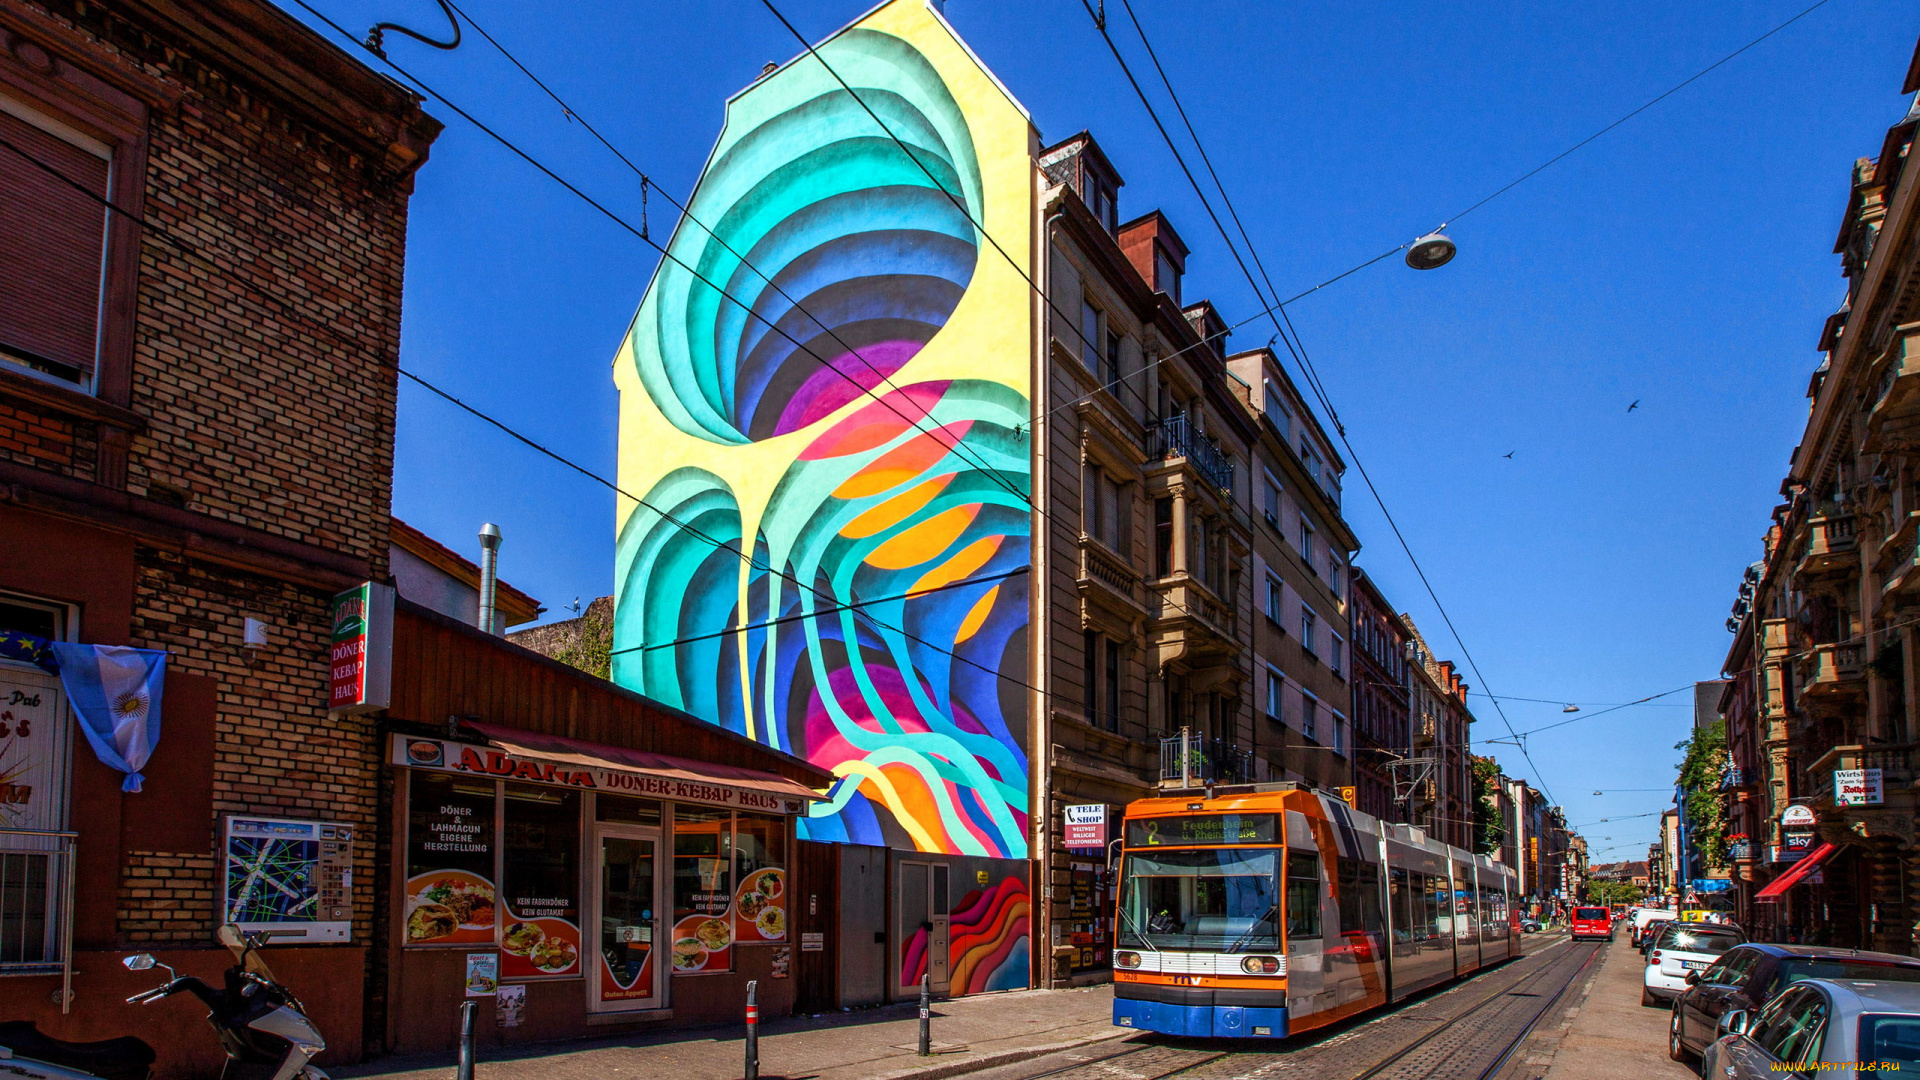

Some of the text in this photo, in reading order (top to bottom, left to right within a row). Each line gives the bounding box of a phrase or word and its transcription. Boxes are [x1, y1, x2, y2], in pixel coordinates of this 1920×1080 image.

[334, 597, 367, 623] ADANA
[333, 640, 365, 661] DÖNER
[333, 661, 363, 680] KEBAP
[335, 681, 359, 699] HAUS
[1842, 785, 1876, 794] Rothaus
[739, 790, 779, 810] HAUS
[440, 804, 472, 816] DÖNER
[1076, 805, 1101, 813] TELE
[454, 816, 461, 824] &
[1182, 820, 1254, 831] Feudenheim
[431, 823, 481, 834] LAHMACUN
[1148, 821, 1159, 845] 2
[440, 833, 473, 843] EIGENE
[1195, 829, 1256, 840] Rheinstraße
[424, 841, 488, 853] HERSTELLUNG
[1788, 837, 1811, 848] sky
[517, 897, 570, 907] KEIN FABRIKDÖNER
[521, 908, 565, 917] KEIN GLUTAMAT
[1123, 973, 1138, 981] 5628
[1173, 974, 1202, 986] rnv
[624, 989, 648, 997] Appetit
